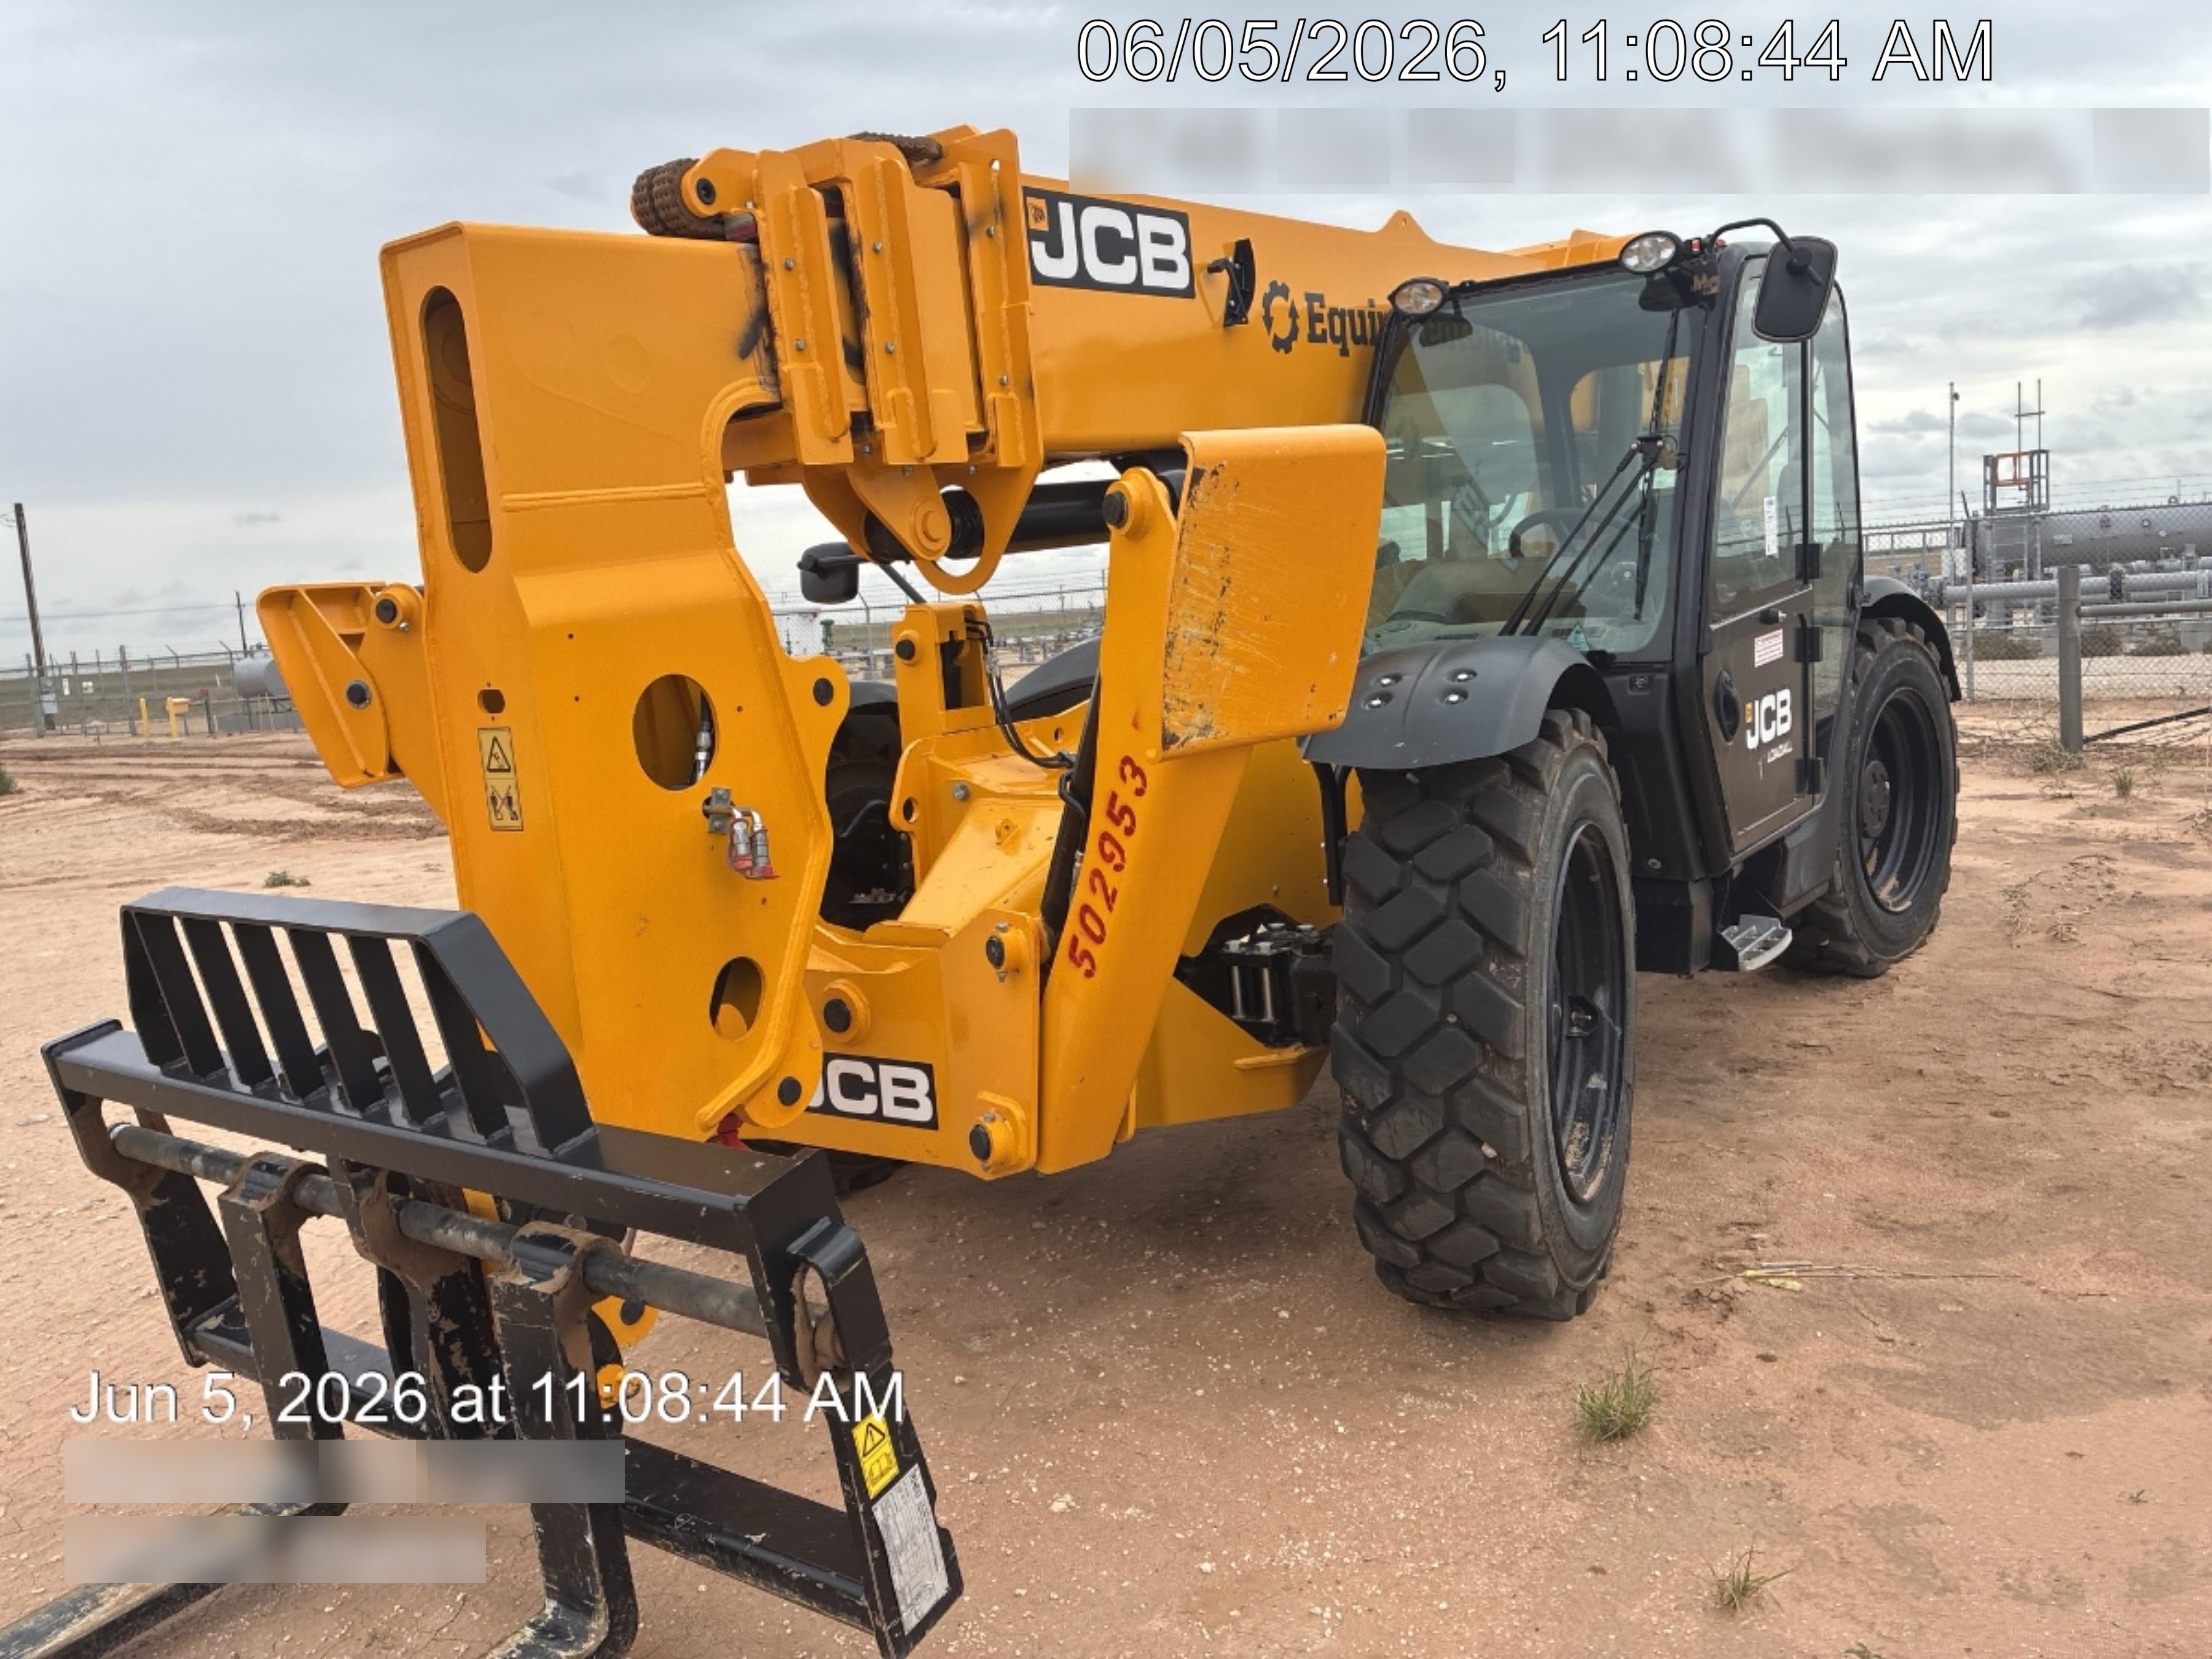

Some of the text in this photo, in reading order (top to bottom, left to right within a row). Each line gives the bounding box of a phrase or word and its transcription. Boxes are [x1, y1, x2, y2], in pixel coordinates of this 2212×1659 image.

[1031, 202, 1189, 288] JCB
[1747, 689, 1792, 749] JCB
[1069, 755, 1147, 978] 502953
